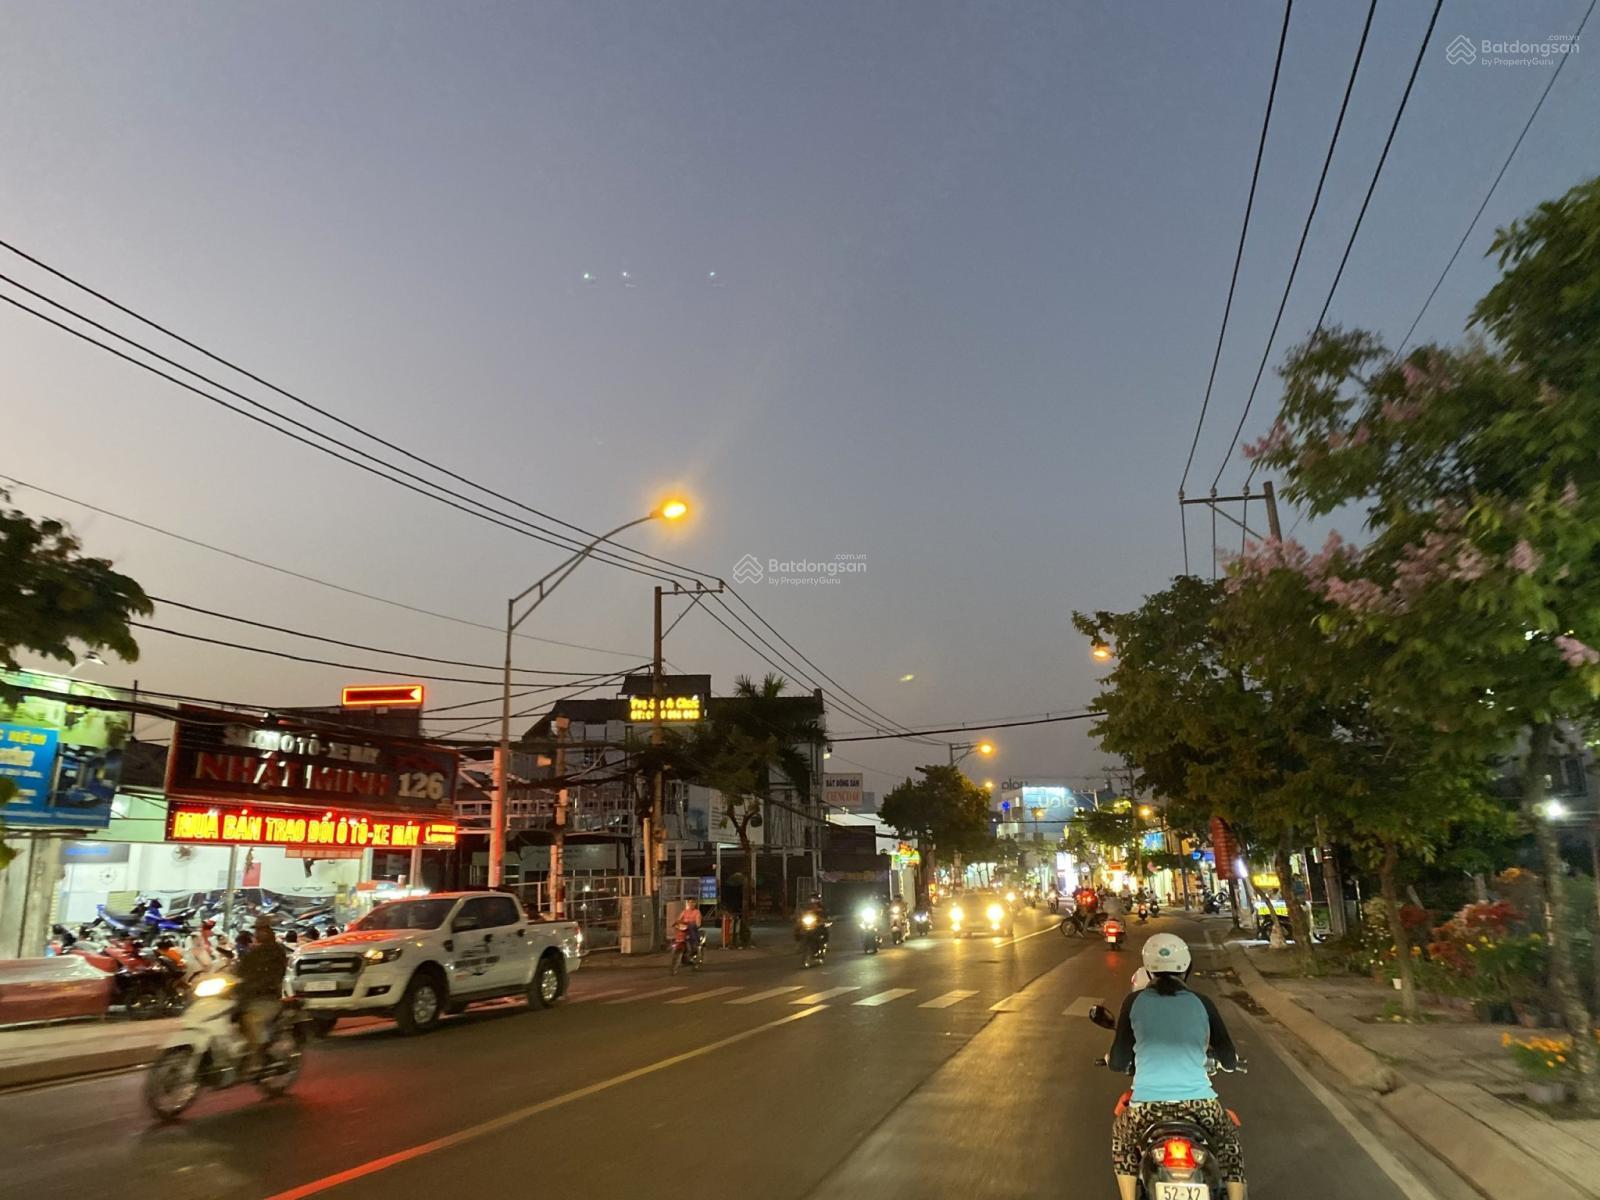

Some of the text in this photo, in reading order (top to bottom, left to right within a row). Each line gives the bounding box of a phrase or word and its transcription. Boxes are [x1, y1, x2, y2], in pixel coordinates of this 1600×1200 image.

[397, 771, 446, 800] 126
[222, 808, 263, 841] BÁN
[264, 816, 307, 843] TRAO
[336, 816, 348, 844] Ô
[391, 820, 420, 846] MÁY
